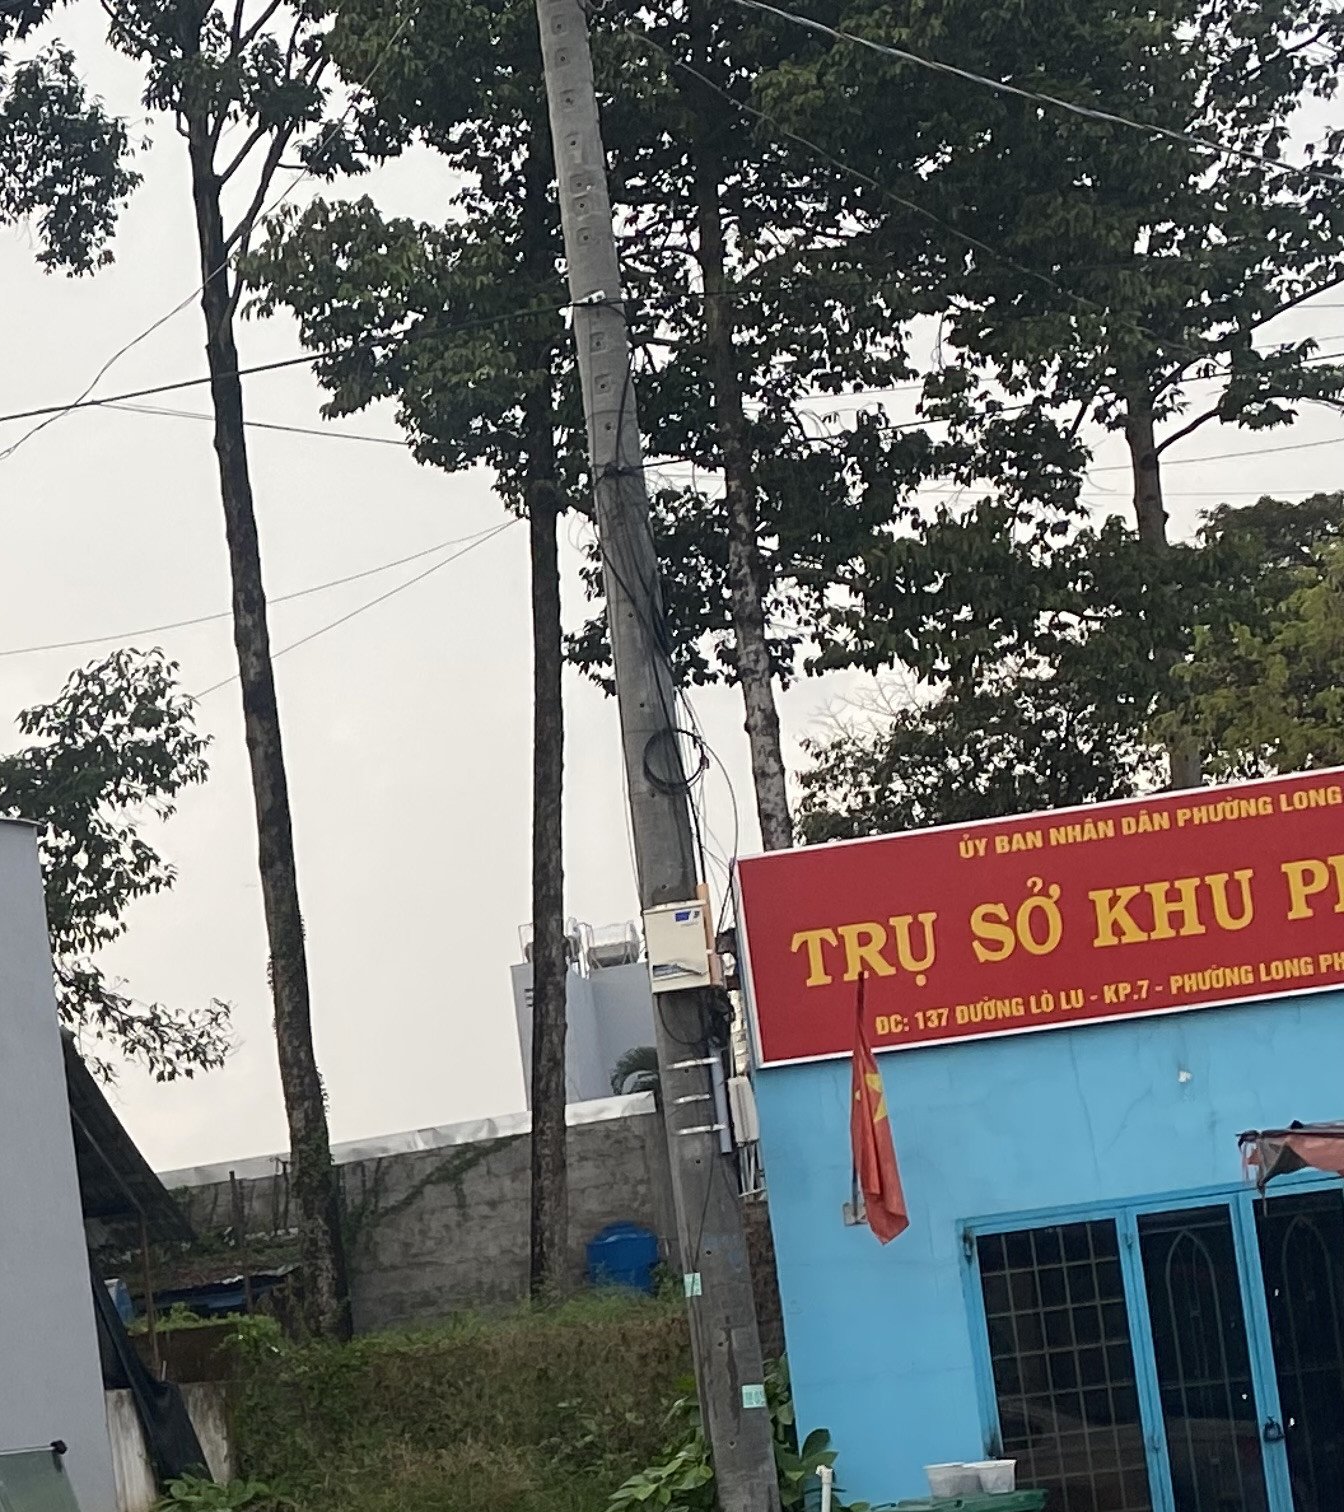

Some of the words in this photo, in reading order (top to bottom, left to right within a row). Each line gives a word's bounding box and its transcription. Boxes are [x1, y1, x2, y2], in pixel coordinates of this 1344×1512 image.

[995, 829, 1043, 854] BAN
[1049, 818, 1115, 847] NHÂN
[1122, 810, 1170, 836] DÂN
[1176, 796, 1274, 827] PHƯỜNG
[1280, 786, 1343, 812] LONG
[790, 911, 938, 987] TRỤ
[969, 877, 1064, 964] SỞ
[1089, 869, 1253, 948] KHU
[914, 1007, 950, 1030] 137
[1060, 988, 1085, 1011] LU
[1103, 979, 1150, 1004] KP.7
[1169, 964, 1254, 995] PHƯỜNG
[1258, 956, 1313, 982] LONG
